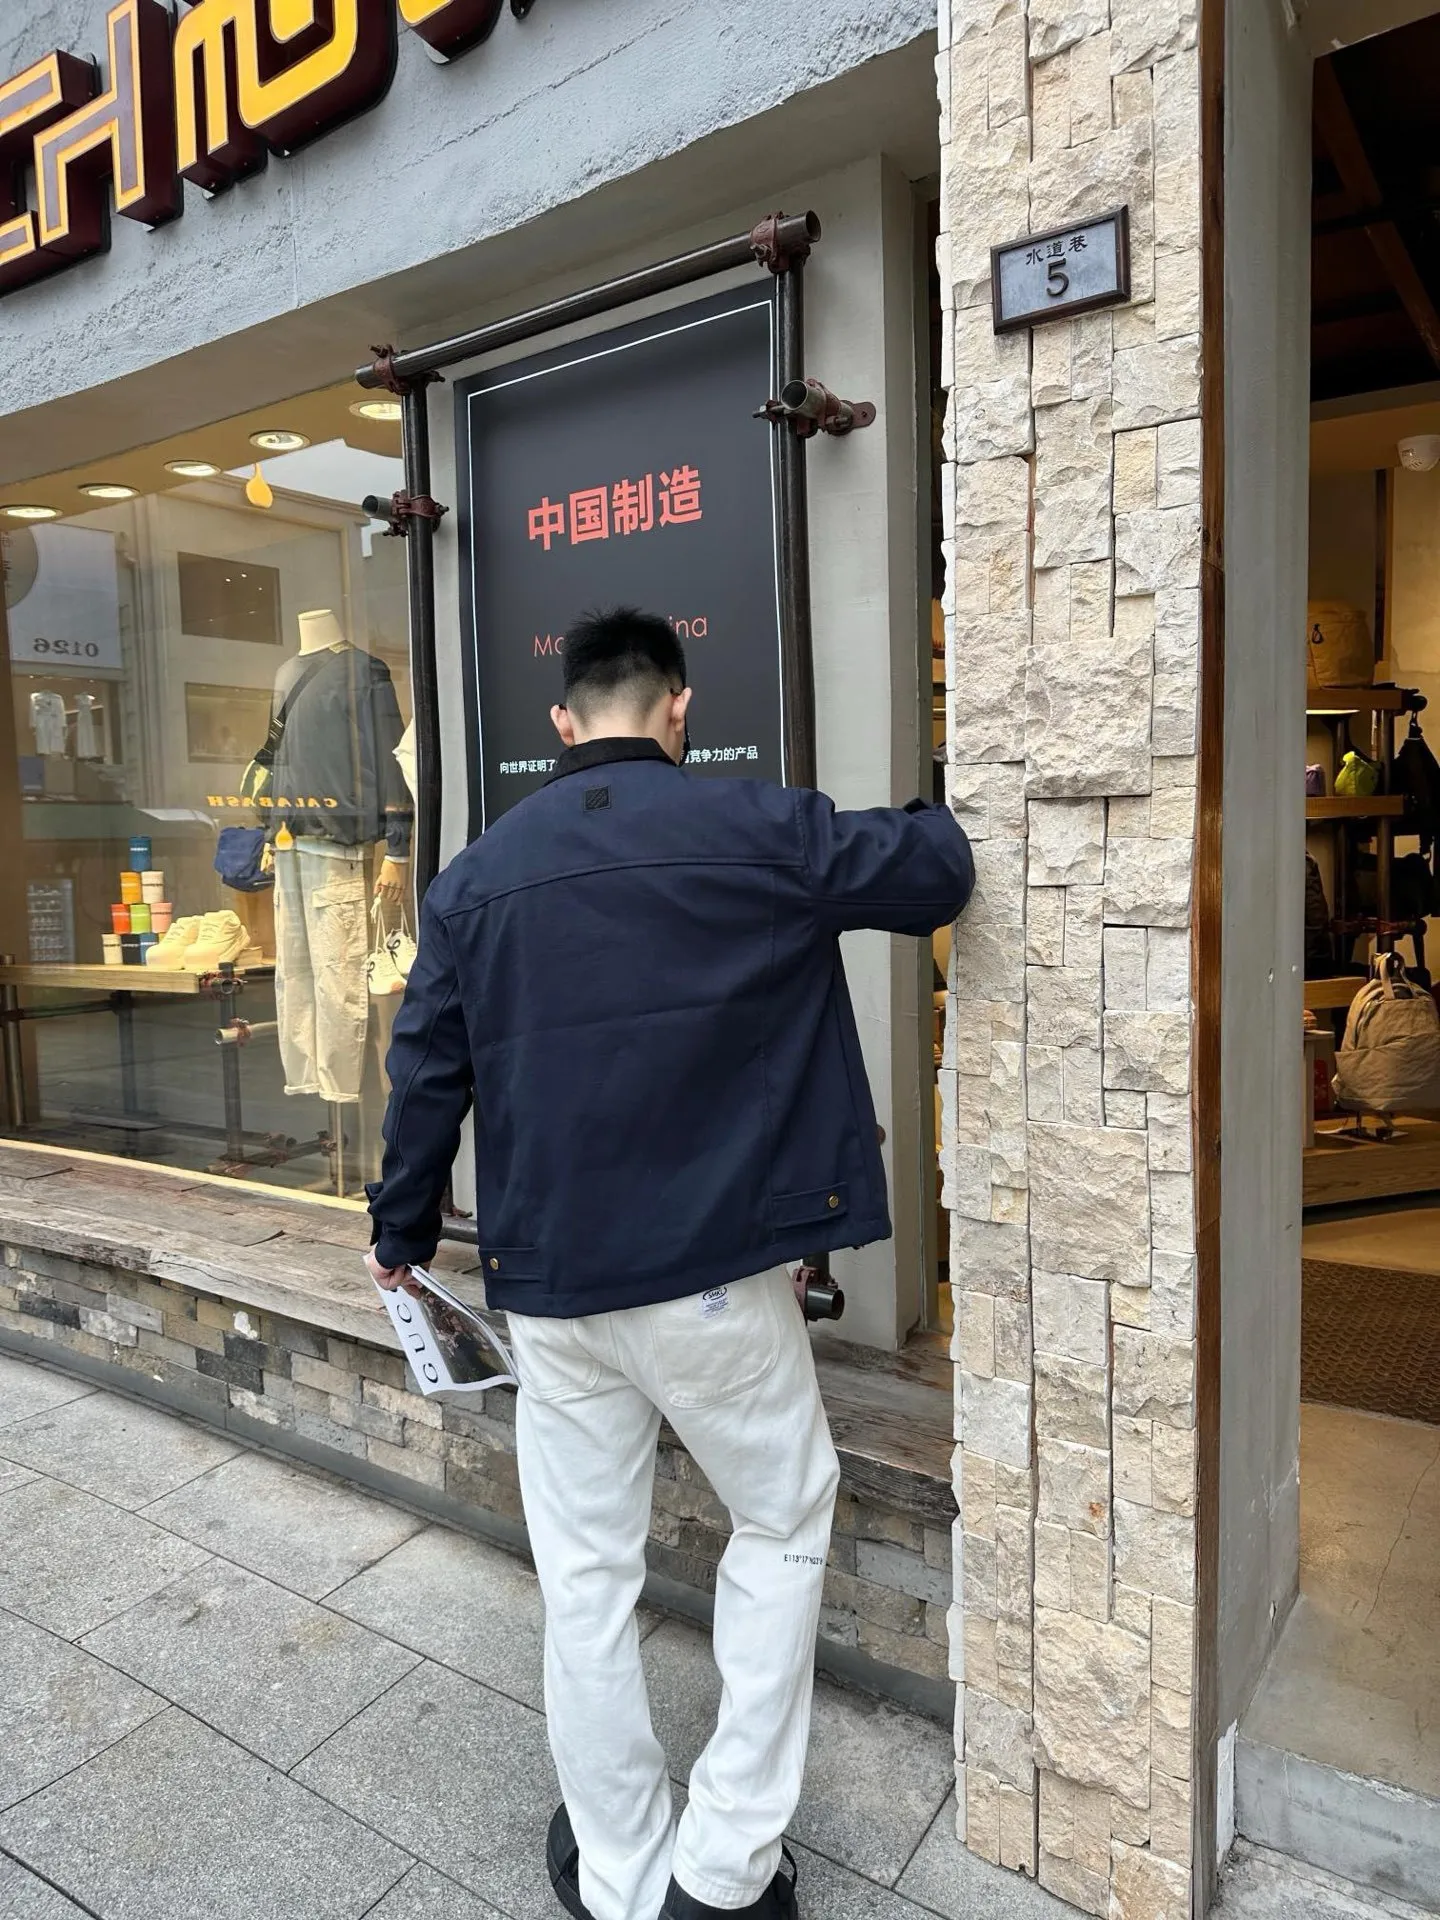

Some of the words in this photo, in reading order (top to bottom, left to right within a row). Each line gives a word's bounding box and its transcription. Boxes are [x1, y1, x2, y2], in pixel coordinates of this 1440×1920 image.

[1025, 235, 1088, 265] 水道巷
[1046, 258, 1069, 297] 5
[528, 465, 702, 550] 中国制造
[499, 758, 558, 775] 向世界证明了
